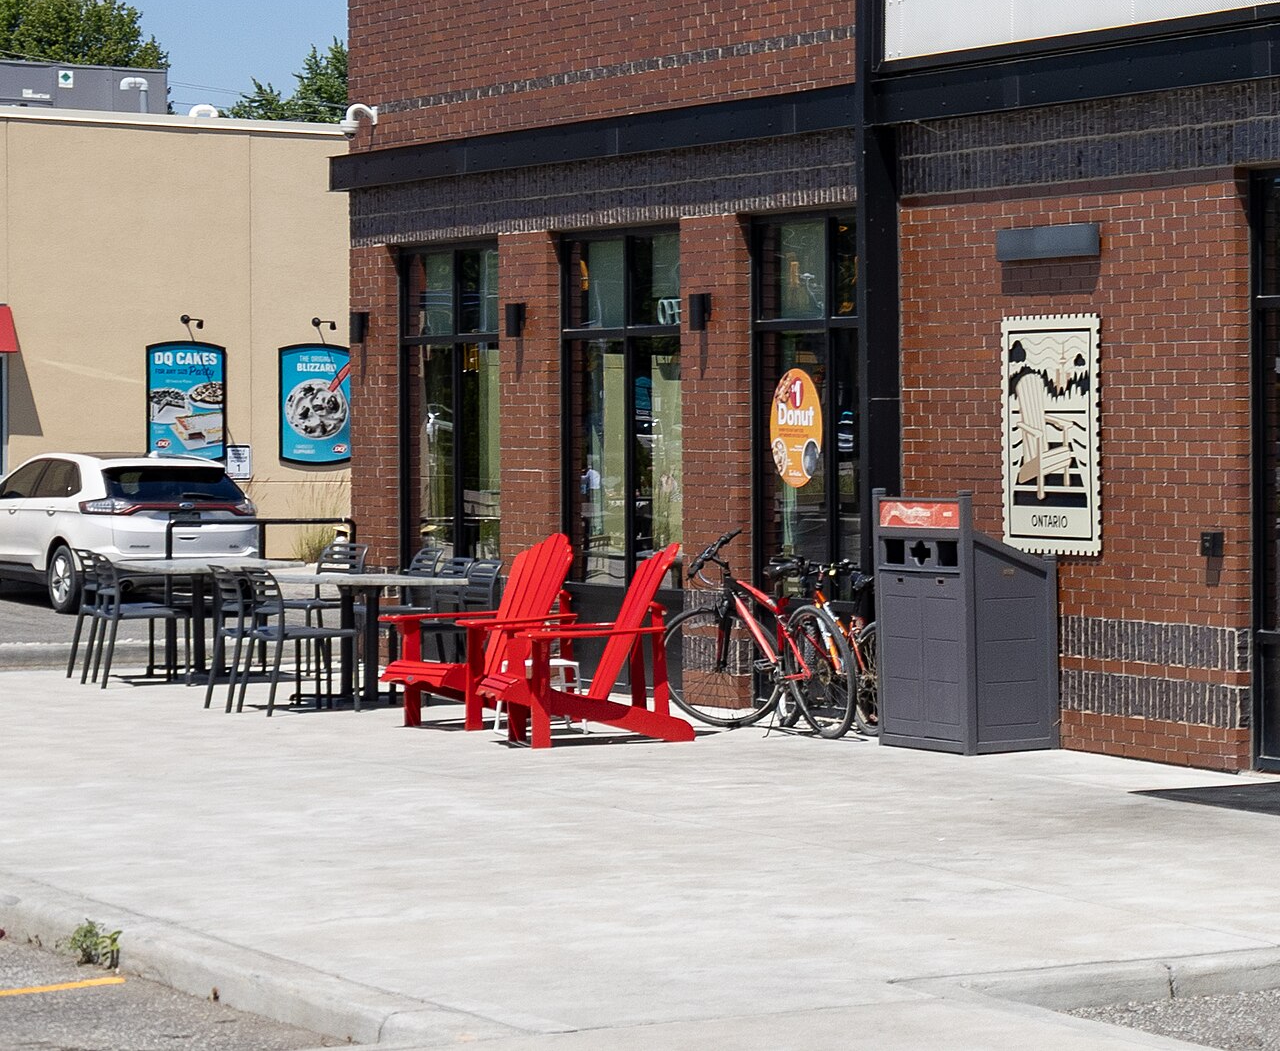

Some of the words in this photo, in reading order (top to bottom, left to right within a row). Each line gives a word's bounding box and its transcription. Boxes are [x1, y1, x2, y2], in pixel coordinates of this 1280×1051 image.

[154, 351, 173, 366] DQ
[176, 351, 218, 365] CAKES
[296, 363, 337, 372] BLIZZARD
[777, 403, 814, 426] Donut
[1031, 514, 1068, 528] ONTARIO
